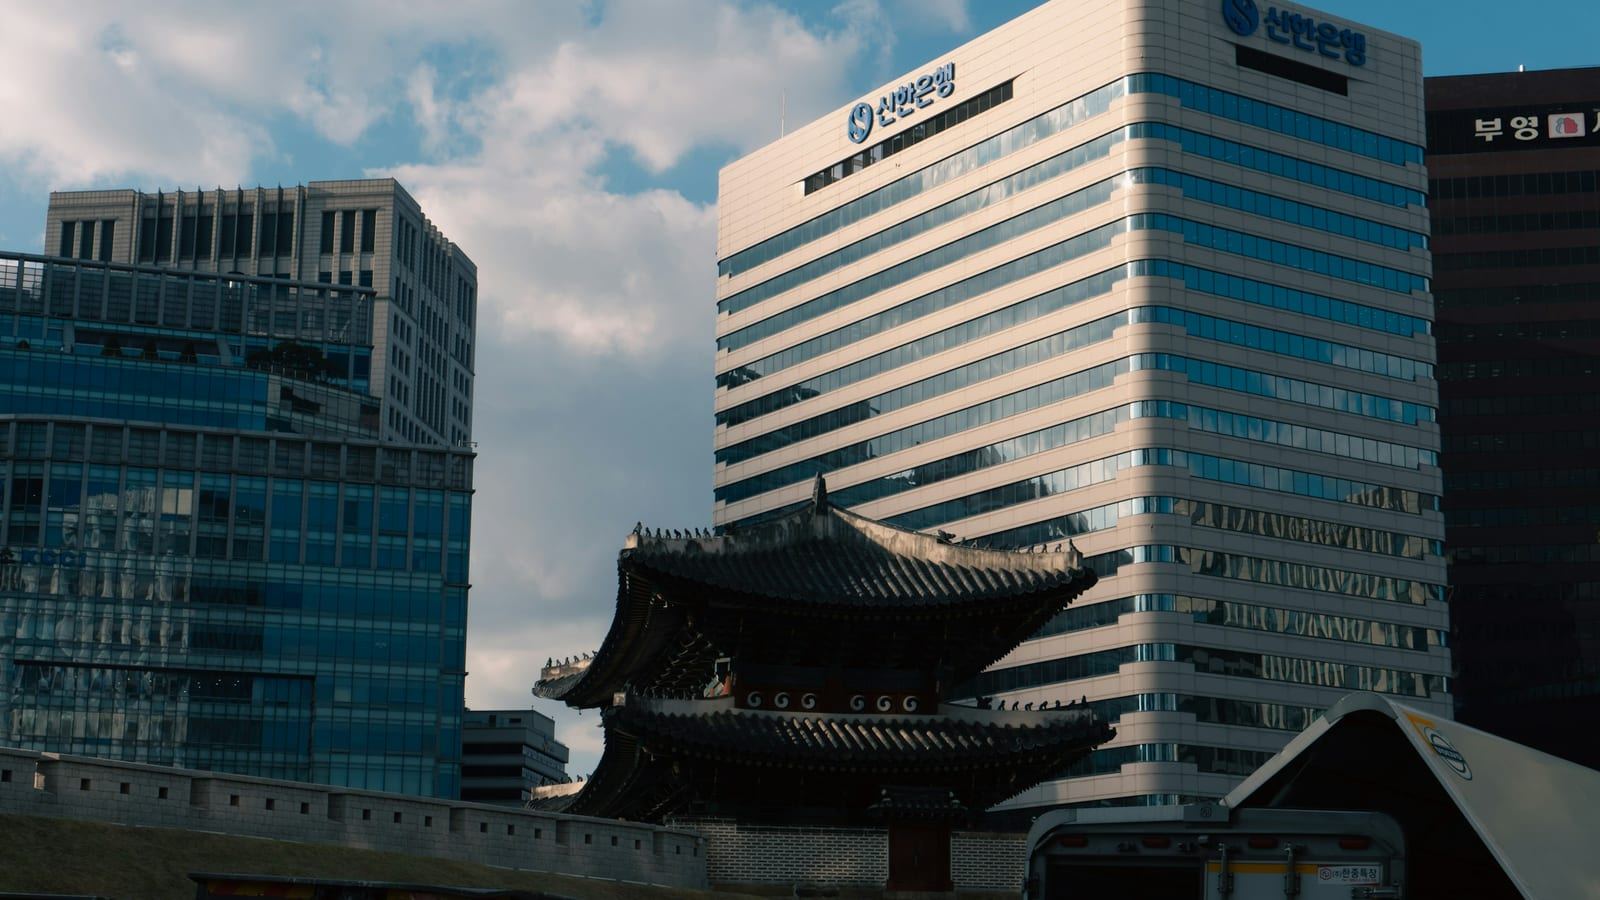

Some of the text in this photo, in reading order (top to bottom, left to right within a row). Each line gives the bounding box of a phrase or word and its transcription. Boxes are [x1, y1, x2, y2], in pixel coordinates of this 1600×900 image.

[1264, 7, 1366, 66] 신한은행
[876, 62, 955, 127] 신한은행
[1474, 115, 1539, 142] 부영
